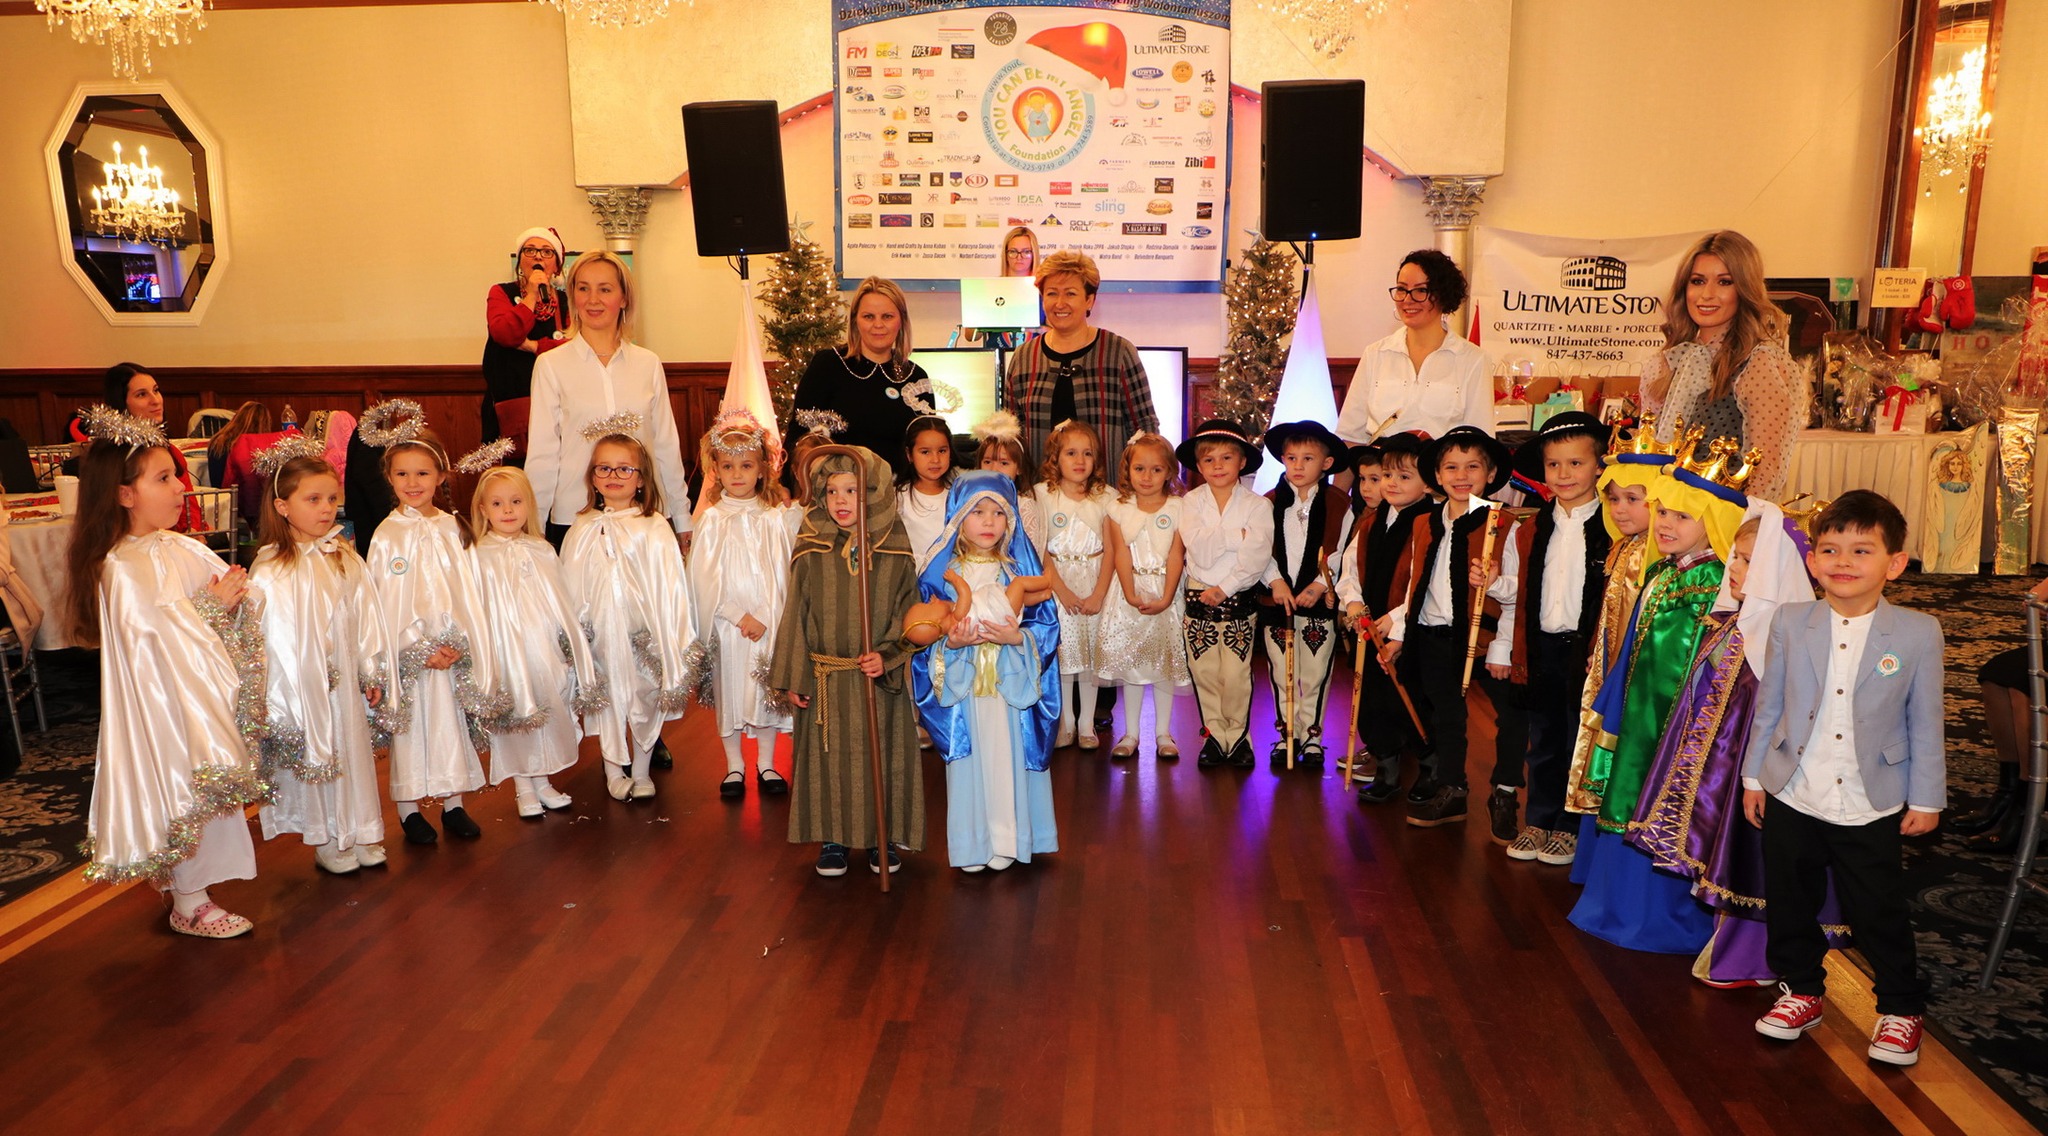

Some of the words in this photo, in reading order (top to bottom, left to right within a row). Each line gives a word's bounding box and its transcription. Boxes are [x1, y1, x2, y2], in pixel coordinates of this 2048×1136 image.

[846, 46, 868, 59] FM
[1133, 44, 1180, 55] ULTIMATE
[1179, 44, 1210, 55] STONE
[1024, 67, 1044, 81] BE
[996, 72, 1024, 103] CAN
[1064, 89, 1084, 138] ANGEL
[993, 107, 1011, 141] YOU
[982, 115, 995, 146] Contact
[1007, 157, 1056, 172] 773-225-9749
[1066, 114, 1095, 160] 773-744-5589
[1009, 144, 1067, 161] Foundation
[1184, 156, 1203, 168] Zibi
[1094, 200, 1126, 215] sling
[1502, 289, 1609, 317] ULTIMATE
[1612, 293, 1664, 315] STON
[1493, 321, 1555, 333] QUARTZITE
[1566, 324, 1612, 334] MARBLE
[1623, 324, 1661, 334] PORCE
[1509, 336, 1665, 348] www.UltimateStone.com
[1546, 349, 1624, 361] 847-437-8663
